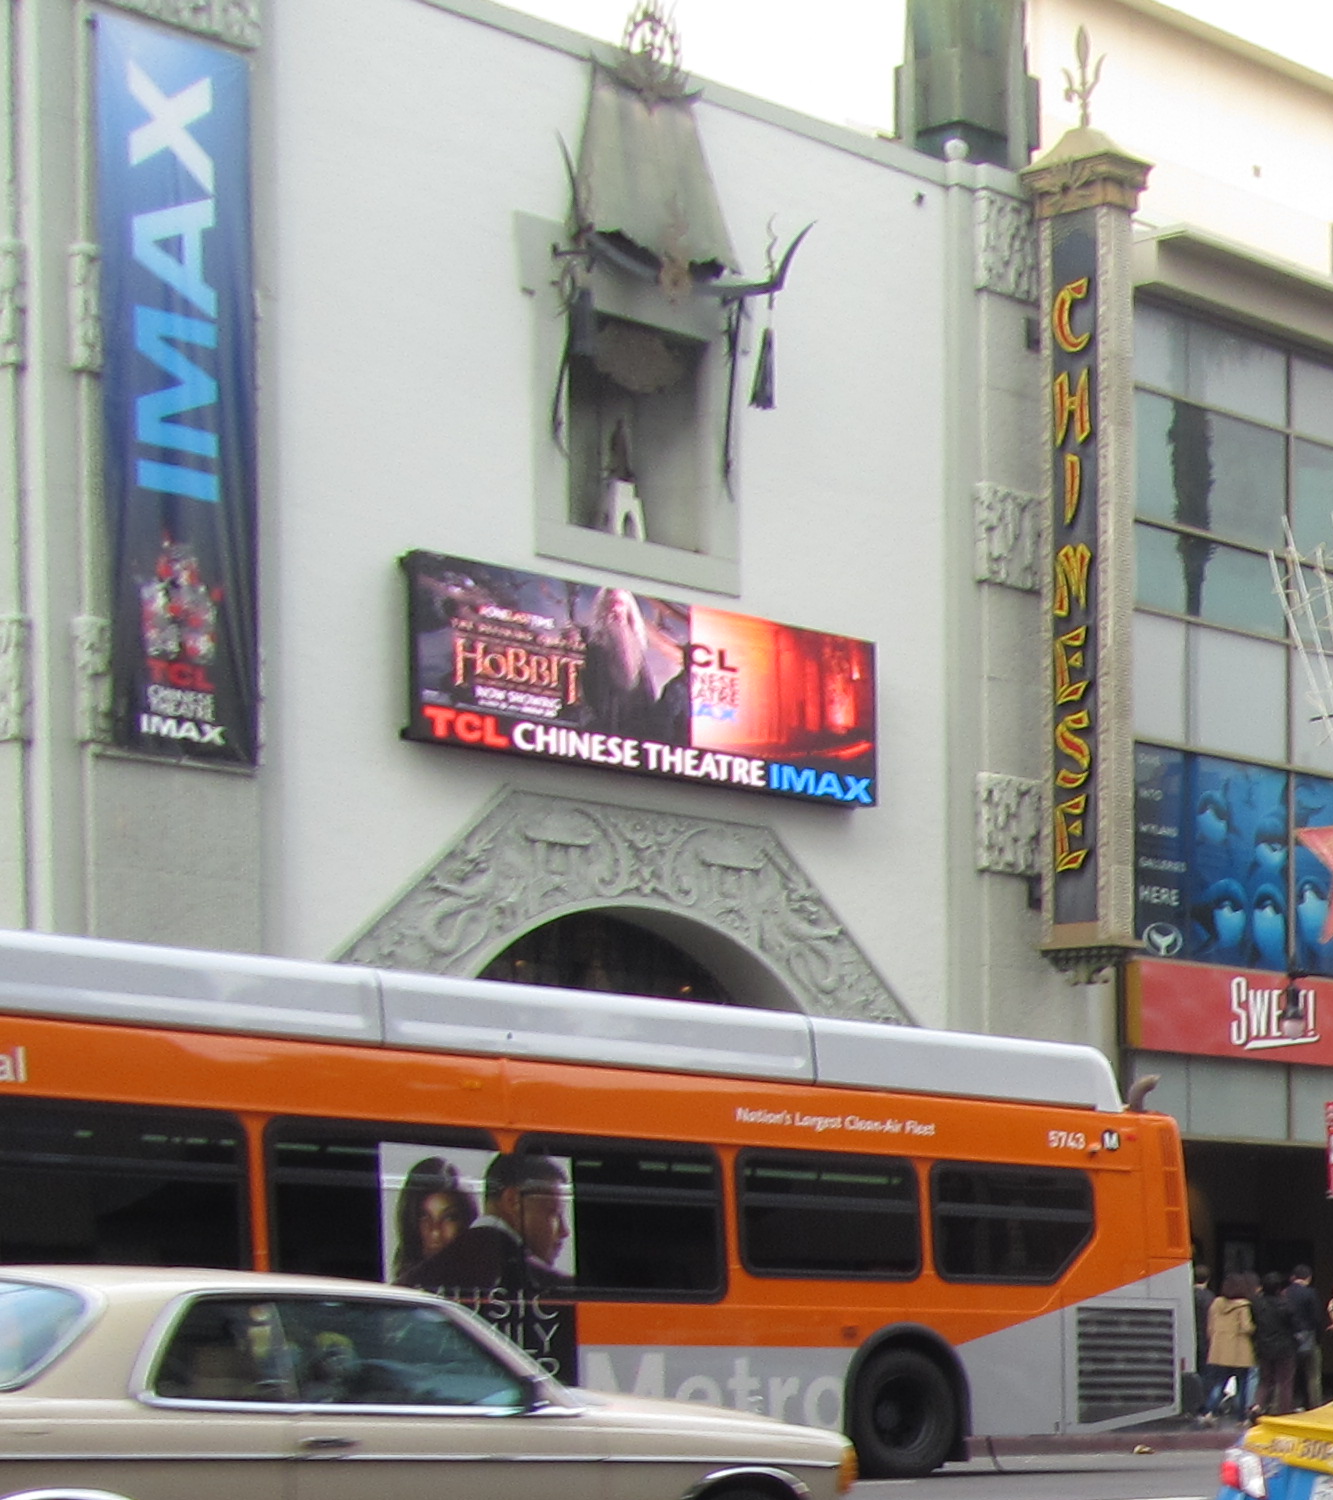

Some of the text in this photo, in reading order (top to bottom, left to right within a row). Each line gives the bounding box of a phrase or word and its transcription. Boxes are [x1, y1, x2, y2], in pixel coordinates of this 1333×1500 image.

[128, 60, 220, 503] IMAX
[1051, 276, 1092, 874] CHINESE
[147, 658, 216, 693] TCL
[690, 643, 738, 673] CL
[140, 713, 228, 747] IMAX
[422, 704, 510, 748] TCL
[513, 722, 641, 768] CHINESE
[642, 741, 767, 787] THEATRE
[769, 763, 873, 804] IMAX
[1138, 885, 1180, 907] HERE
[735, 1107, 935, 1136] Nation's Largest Clean-Air Fleet
[585, 1351, 846, 1430] Metro
